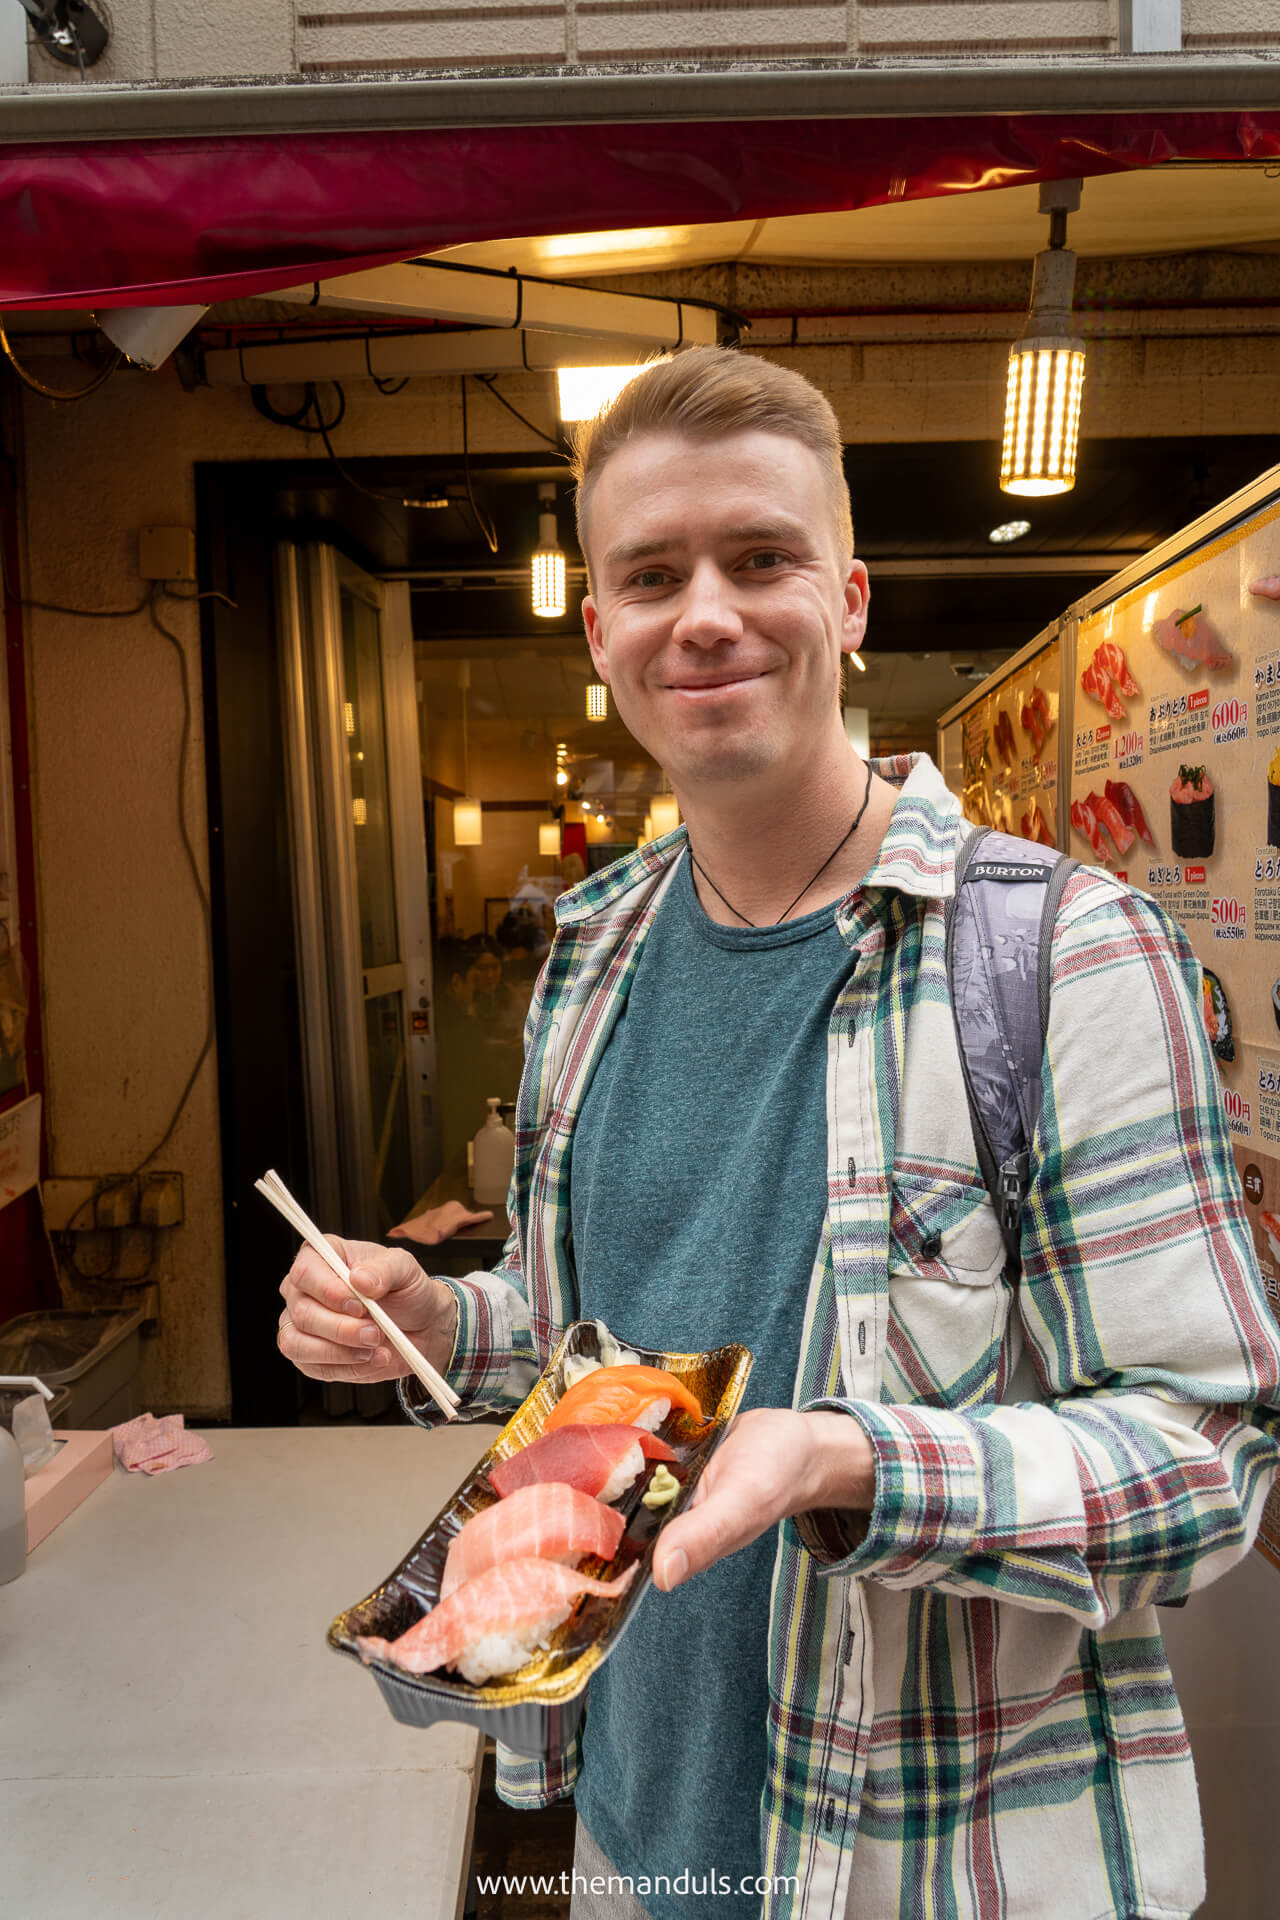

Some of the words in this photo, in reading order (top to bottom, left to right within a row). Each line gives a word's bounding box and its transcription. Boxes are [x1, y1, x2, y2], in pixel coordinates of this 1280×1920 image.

[1212, 699, 1248, 730] 600円
[975, 866, 1045, 876] BURTON
[1149, 866, 1181, 883] ねぎとろ
[1211, 898, 1246, 924] 500円
[1224, 1090, 1250, 1121] 00円
